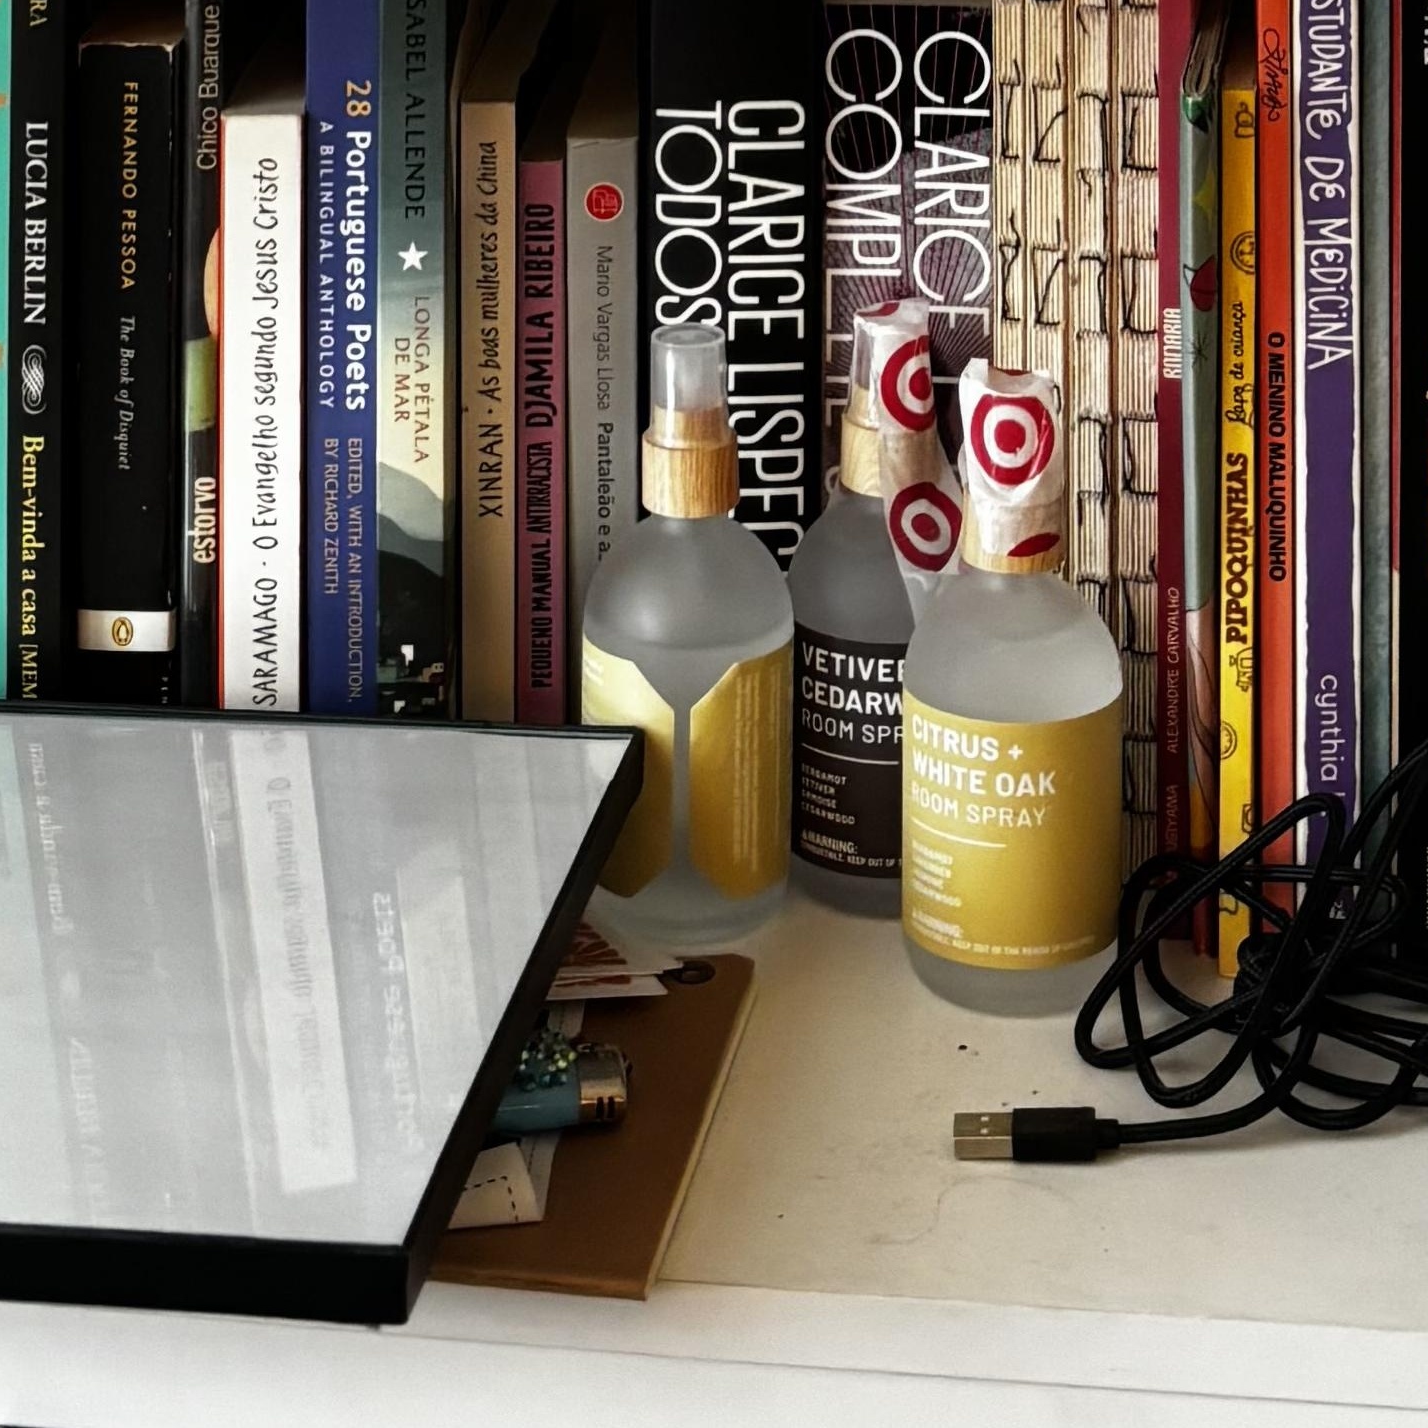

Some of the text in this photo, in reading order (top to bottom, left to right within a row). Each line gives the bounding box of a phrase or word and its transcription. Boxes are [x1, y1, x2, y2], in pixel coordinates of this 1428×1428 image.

[22, 123, 49, 210] LUCIA
[403, 94, 427, 219] ALLENDE
[654, 100, 724, 326] TODOS
[727, 100, 807, 343] CLARICE
[912, 30, 992, 338] CLARICE
[22, 221, 49, 326] BERLIN
[113, 81, 140, 471] FERNANDO PESSOA Disquiet
[186, 4, 222, 565] estorvo Chico Buarque
[318, 145, 335, 408] BILINGUAL ANTHOLOGY
[338, 80, 372, 410] 28 Portuguese Poets
[413, 296, 431, 374] LONGA
[473, 141, 504, 519] XINRAN mulheres China
[524, 203, 558, 612] MANUAL ANTIRRACISTA DJAMILA RIBEIRO
[592, 302, 619, 518] Vargas Pantaleão
[19, 435, 45, 564] Bem-vinda
[251, 157, 280, 707] SARAMAGO Evangelho segundo Jesus Cristo
[1266, 354, 1287, 583] MENINO MALUQUINHO
[323, 464, 341, 594] RICHARD ZENITH
[1226, 452, 1254, 646] PIPOQUINHAS
[346, 579, 365, 701] INTRODUCTION,
[801, 675, 903, 716] CEDARW
[801, 708, 904, 745] ROOM SPR
[911, 712, 1000, 762] CITRUS
[911, 781, 1047, 829] ROOM SPRAY
[912, 752, 1057, 797] WHITE OAK
[1314, 675, 1347, 784] cynthia
